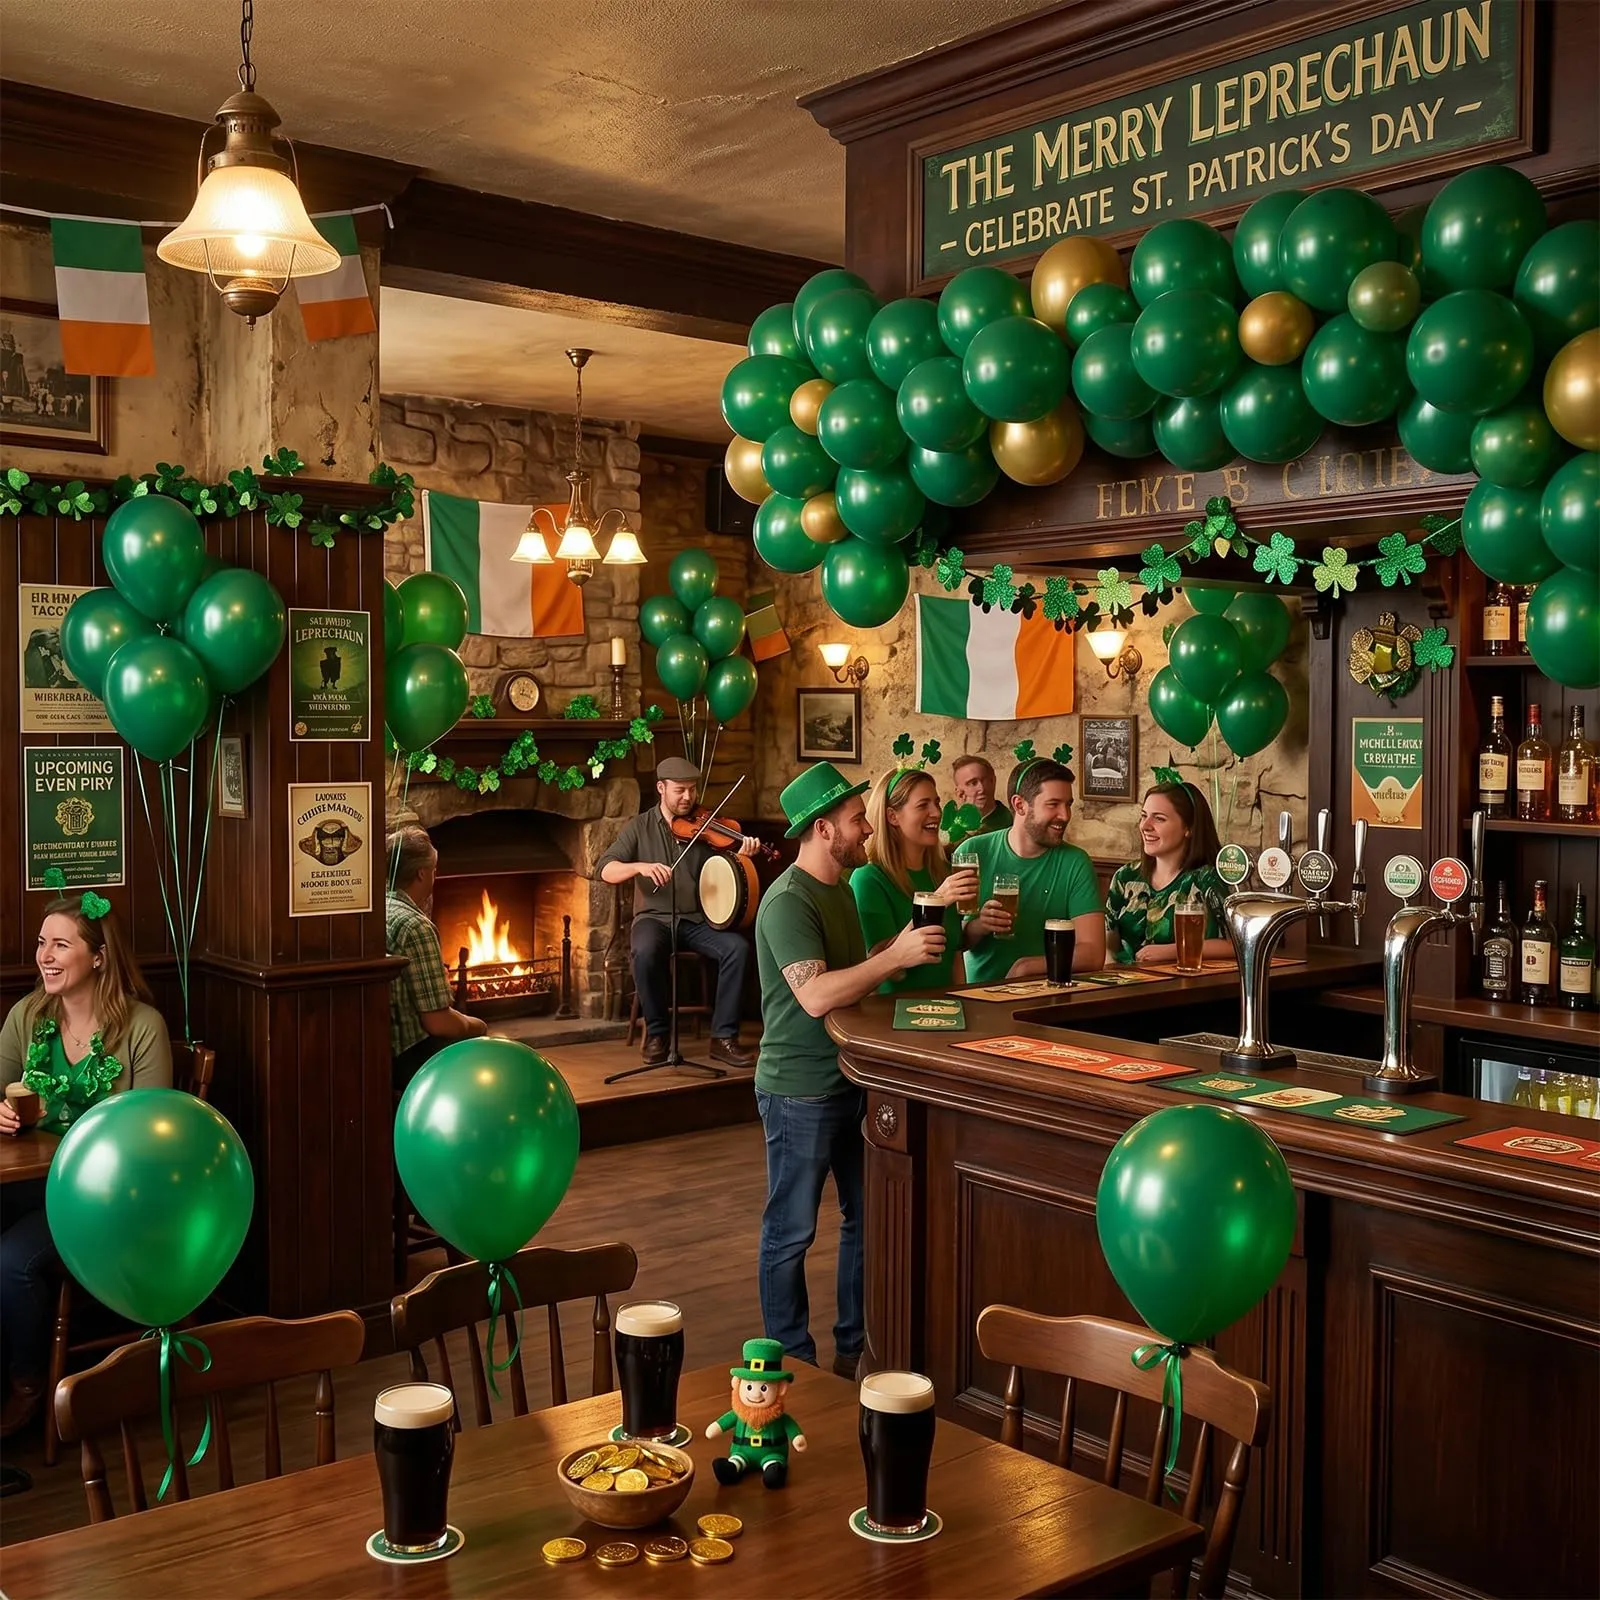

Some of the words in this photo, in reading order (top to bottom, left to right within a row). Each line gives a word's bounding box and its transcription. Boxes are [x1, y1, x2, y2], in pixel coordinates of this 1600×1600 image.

[940, 145, 1015, 213] THE
[1032, 97, 1173, 190] MERRY
[1189, 0, 1492, 145] LEPRECHAUN
[965, 186, 1115, 257] CELEBRATE
[1131, 171, 1173, 215] ST.
[1188, 121, 1351, 201] PATRICK'S
[1371, 97, 1444, 155] DAY
[295, 627, 364, 647] LEPRECHAUN
[34, 760, 114, 775] UPCOMING
[35, 777, 76, 793] EVEN
[80, 776, 114, 791] PIRY
